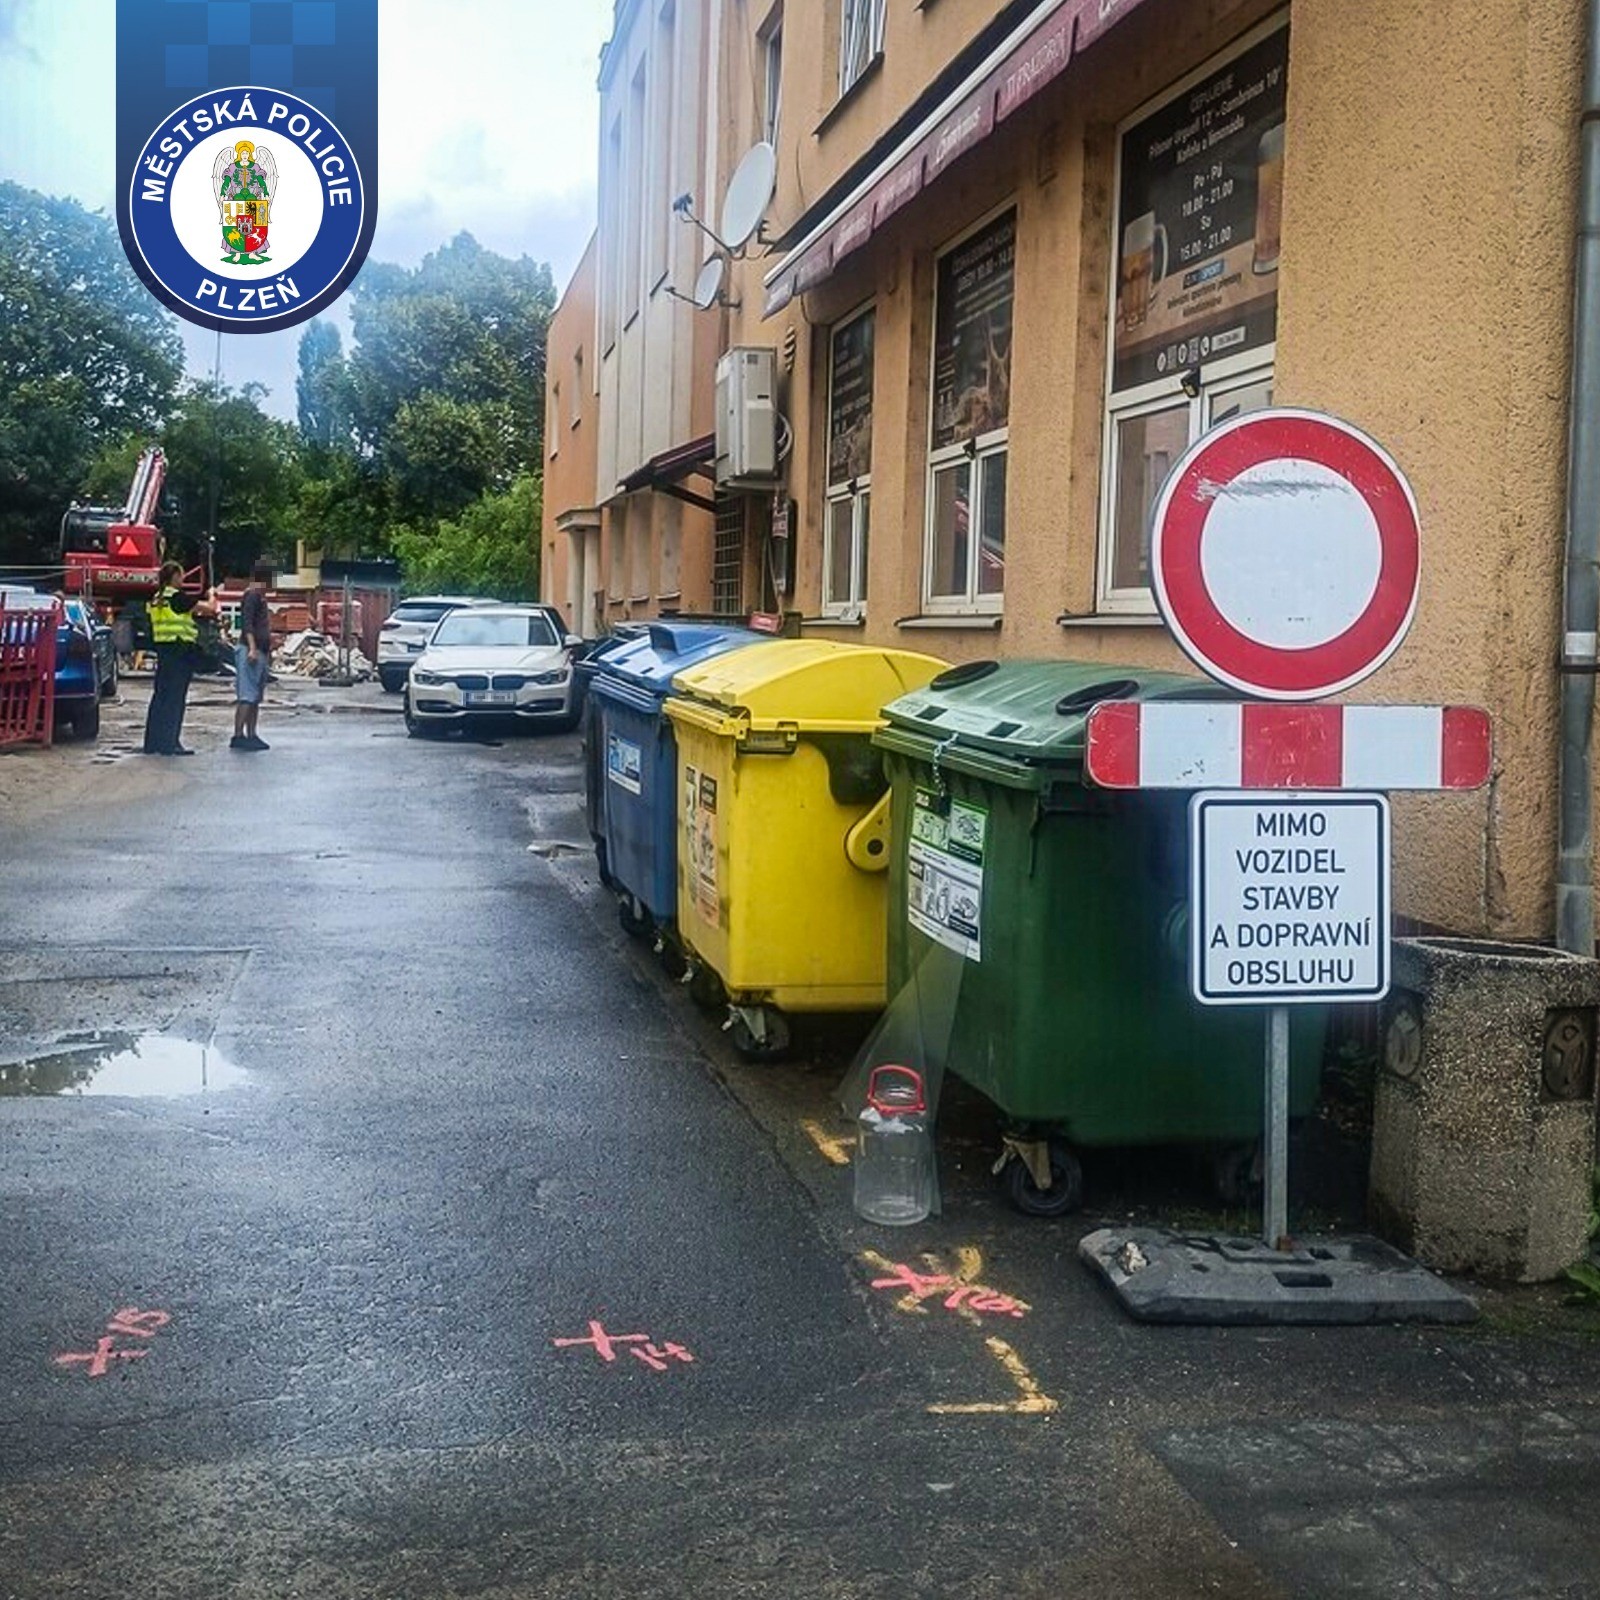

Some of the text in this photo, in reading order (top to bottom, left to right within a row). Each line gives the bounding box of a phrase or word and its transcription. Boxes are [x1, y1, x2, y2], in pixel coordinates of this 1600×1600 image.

[1193, 174, 1205, 190] Po
[1210, 178, 1234, 204] 21.00
[1200, 215, 1212, 231] So
[1208, 225, 1232, 250] 21.00
[1256, 812, 1327, 838] MIMO
[1235, 848, 1346, 874] VOZIDEL
[1242, 885, 1340, 911] STAVBY
[1210, 917, 1371, 949] A DOPRAVNÍ
[1227, 959, 1354, 986] OBSLUHU
